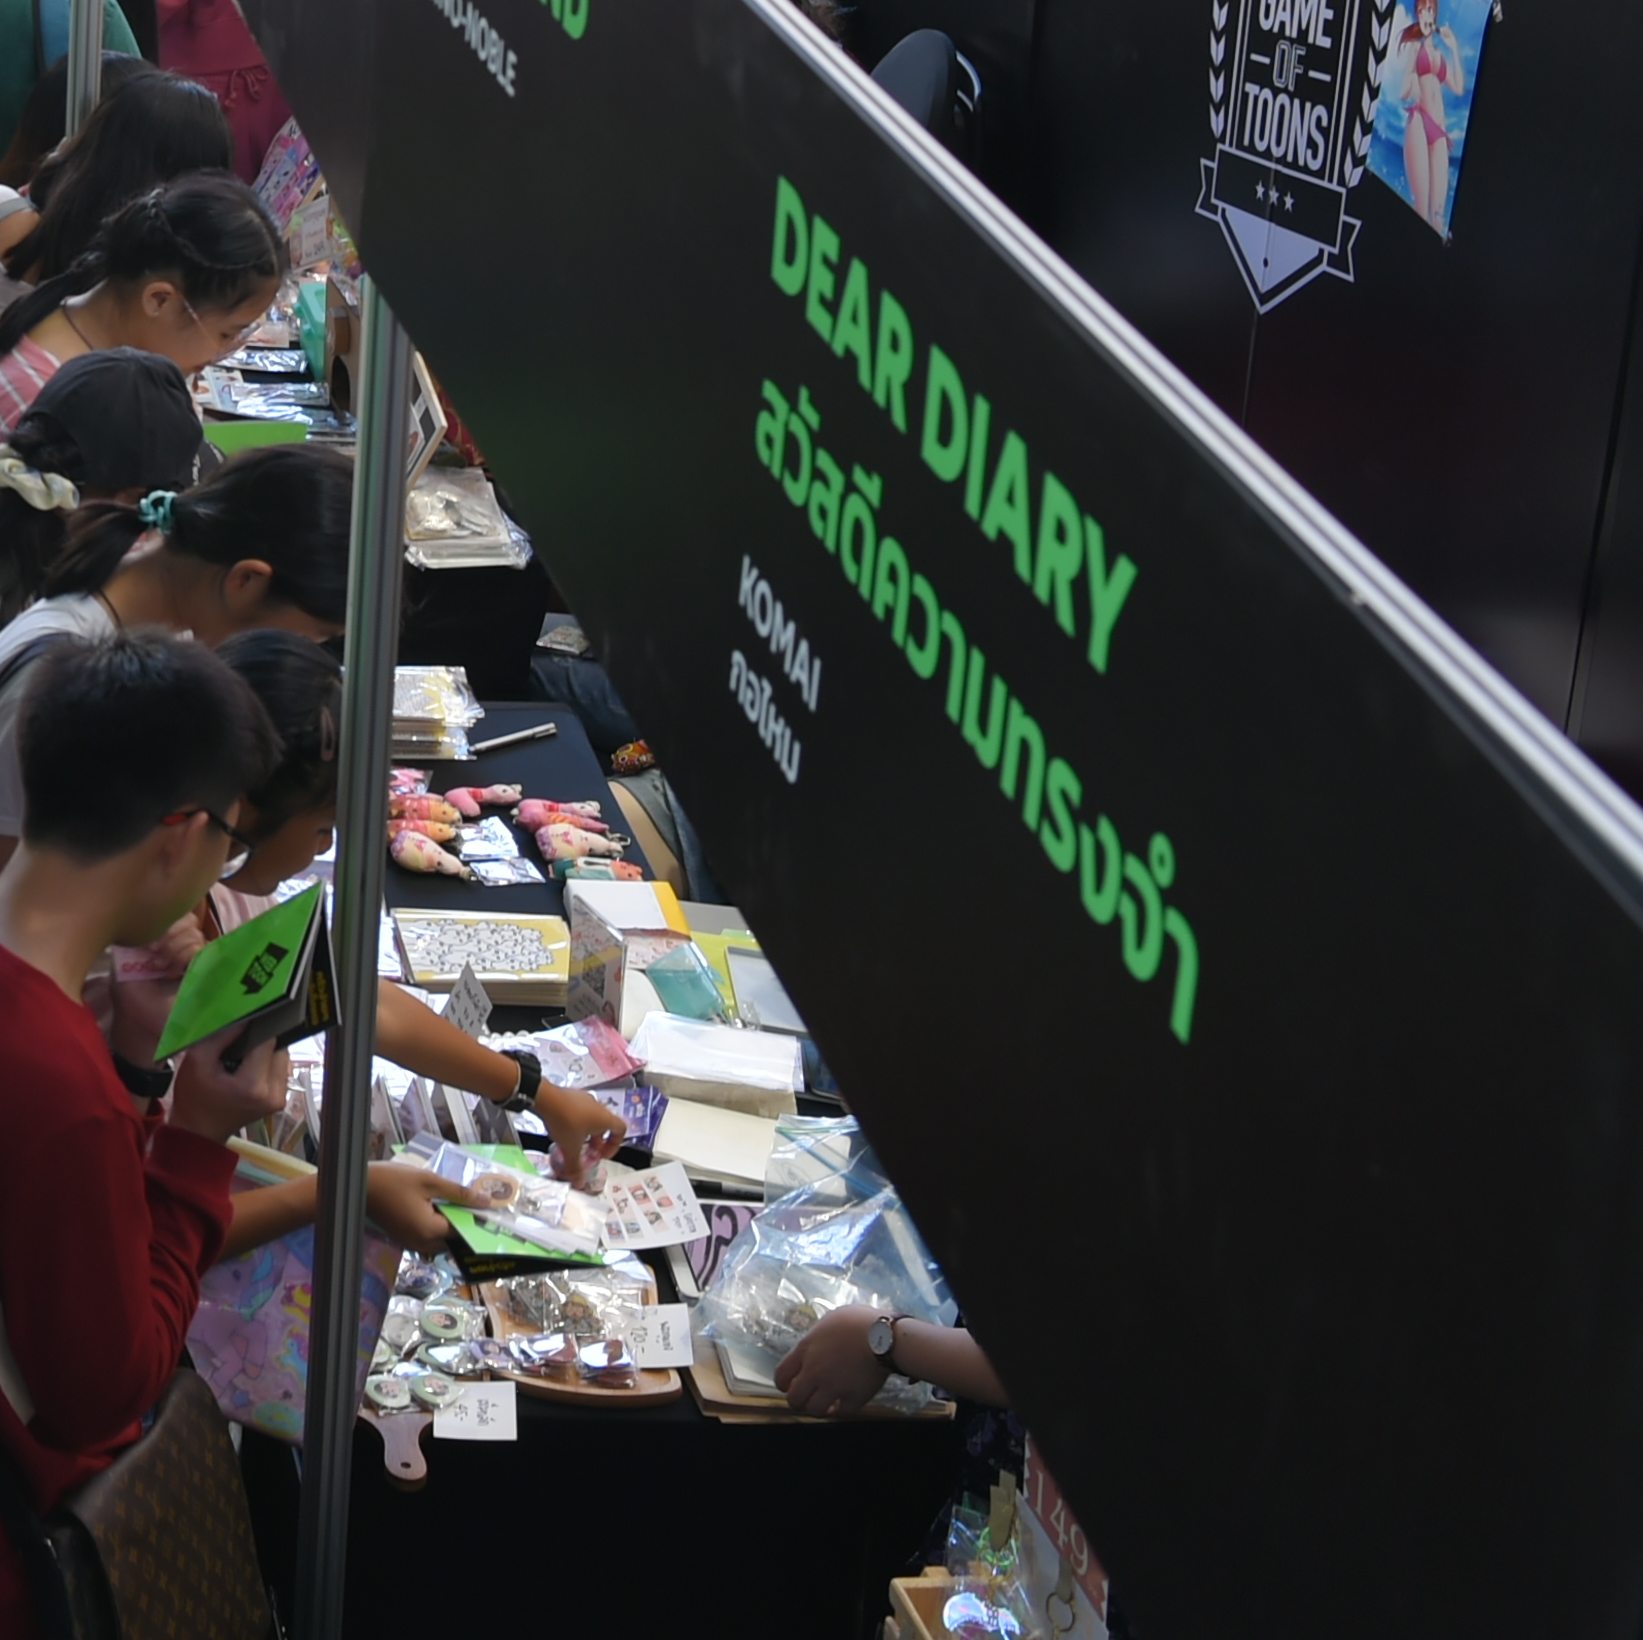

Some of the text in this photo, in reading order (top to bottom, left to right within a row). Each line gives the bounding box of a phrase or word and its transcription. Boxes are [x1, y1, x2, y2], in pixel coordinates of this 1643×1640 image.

[1243, 81, 1329, 171] TOONS
[1272, 39, 1307, 93] OF
[771, 175, 1138, 675] DEAR DIARY
[737, 554, 822, 713] KOMAI
[755, 377, 1199, 1045] สวัสดีความทรงจำ
[1034, 1469, 1089, 1576] 149
